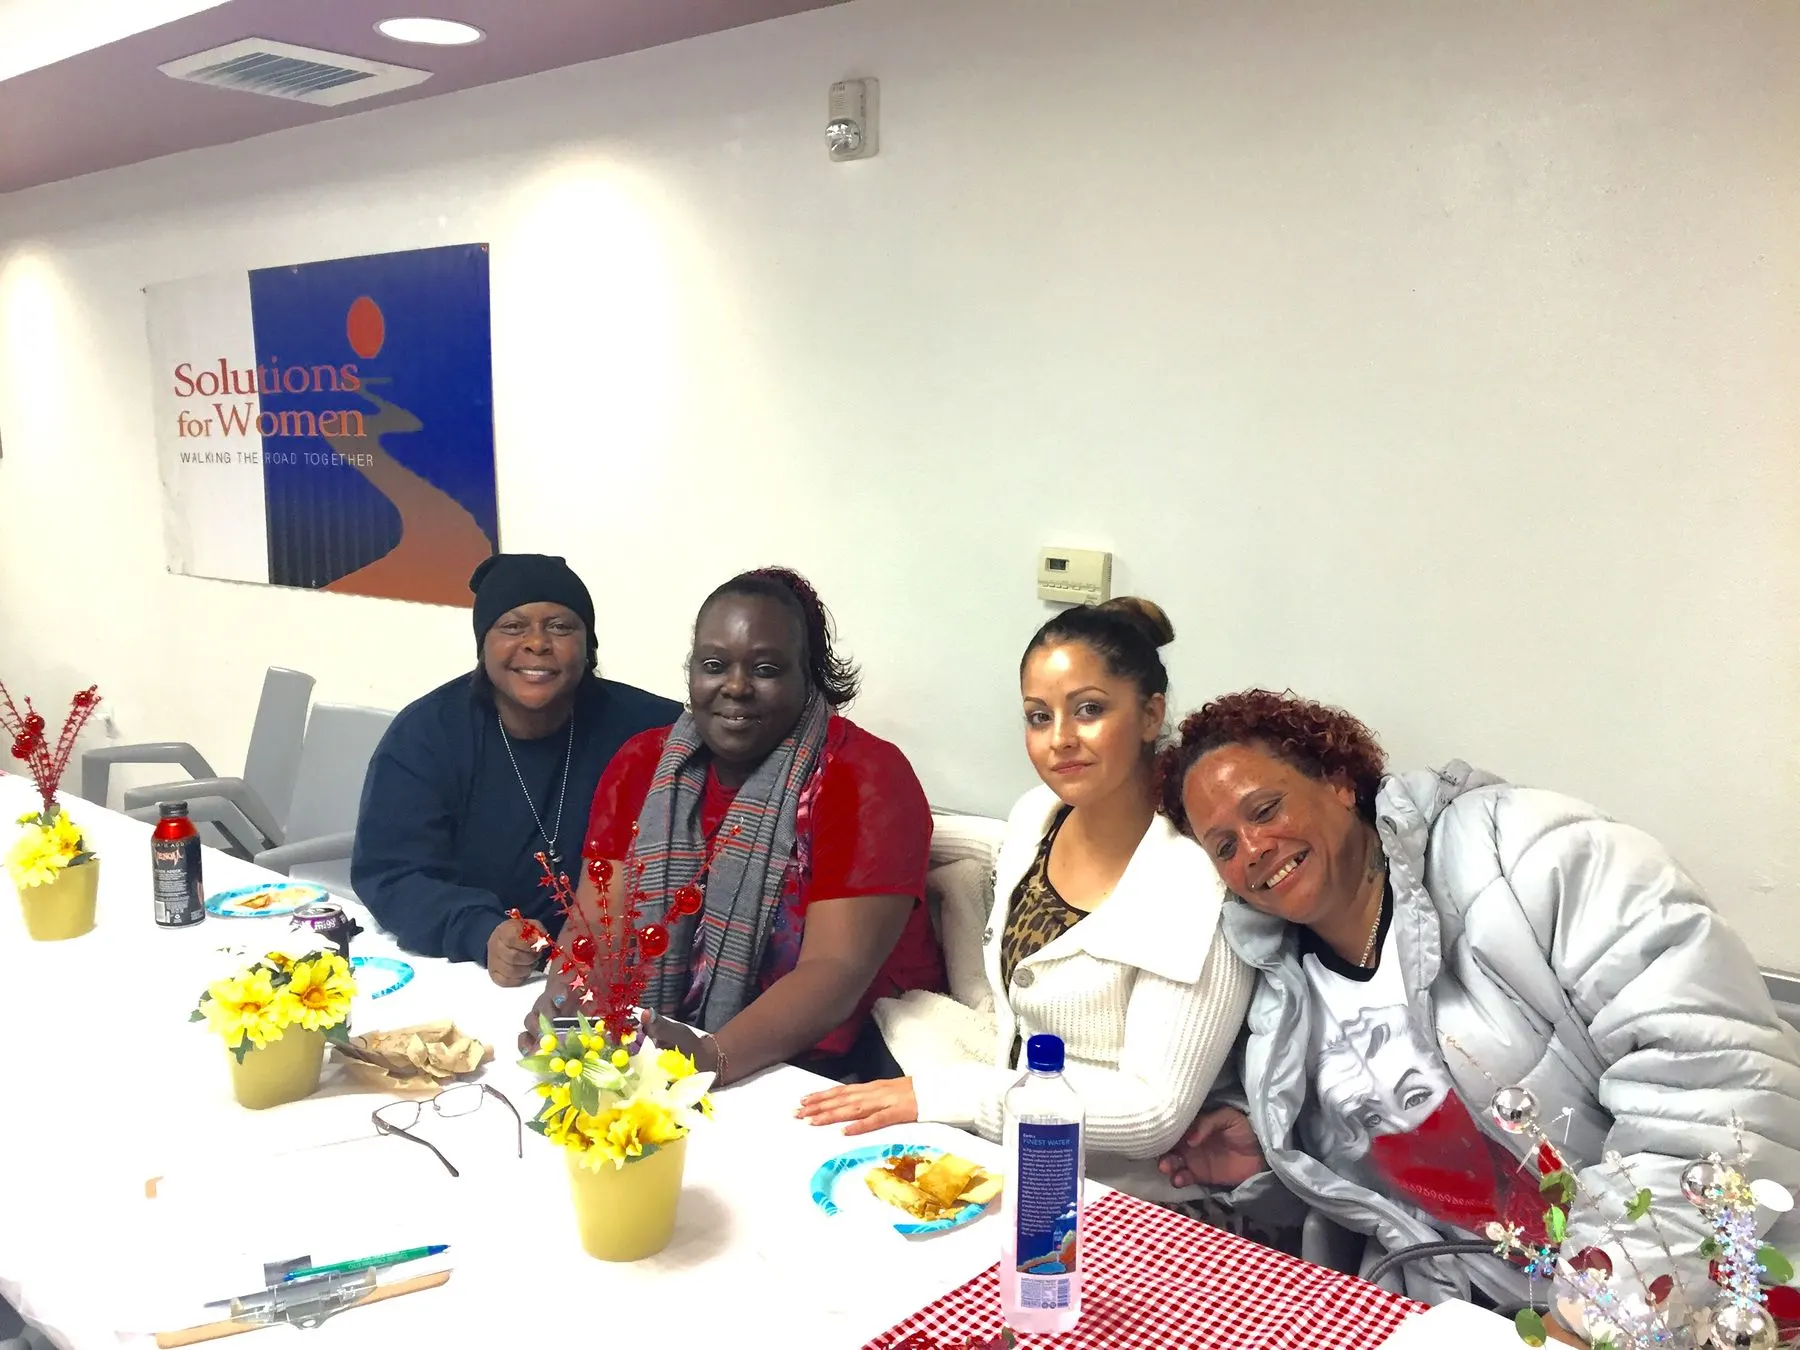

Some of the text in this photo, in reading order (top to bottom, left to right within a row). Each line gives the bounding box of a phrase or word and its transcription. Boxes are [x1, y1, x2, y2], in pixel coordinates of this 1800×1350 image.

[174, 355, 361, 397] Solutions
[177, 401, 367, 438] for Women
[180, 451, 374, 467] WALKING THE ROAD TOGETHER
